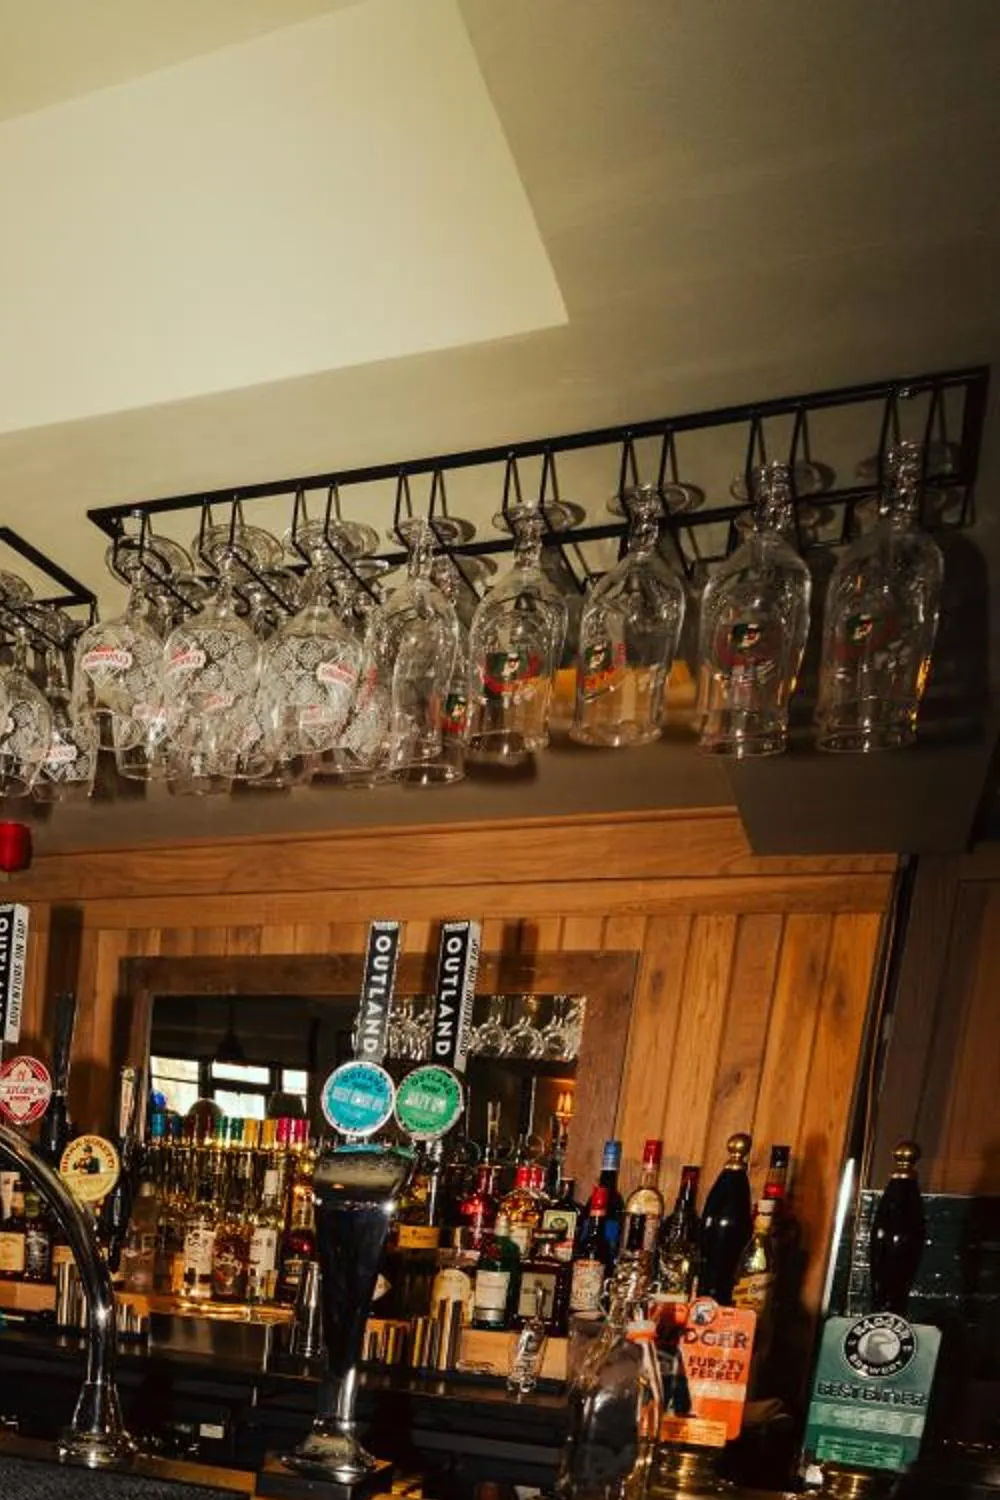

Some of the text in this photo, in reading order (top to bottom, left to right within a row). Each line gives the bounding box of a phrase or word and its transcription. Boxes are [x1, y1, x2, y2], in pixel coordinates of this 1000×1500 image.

[363, 935, 391, 1053] OUTLAND
[435, 937, 463, 1056] OUTLAND
[683, 1327, 748, 1350] DGER
[688, 1354, 745, 1372] FURSTY
[817, 1380, 860, 1399] BEST
